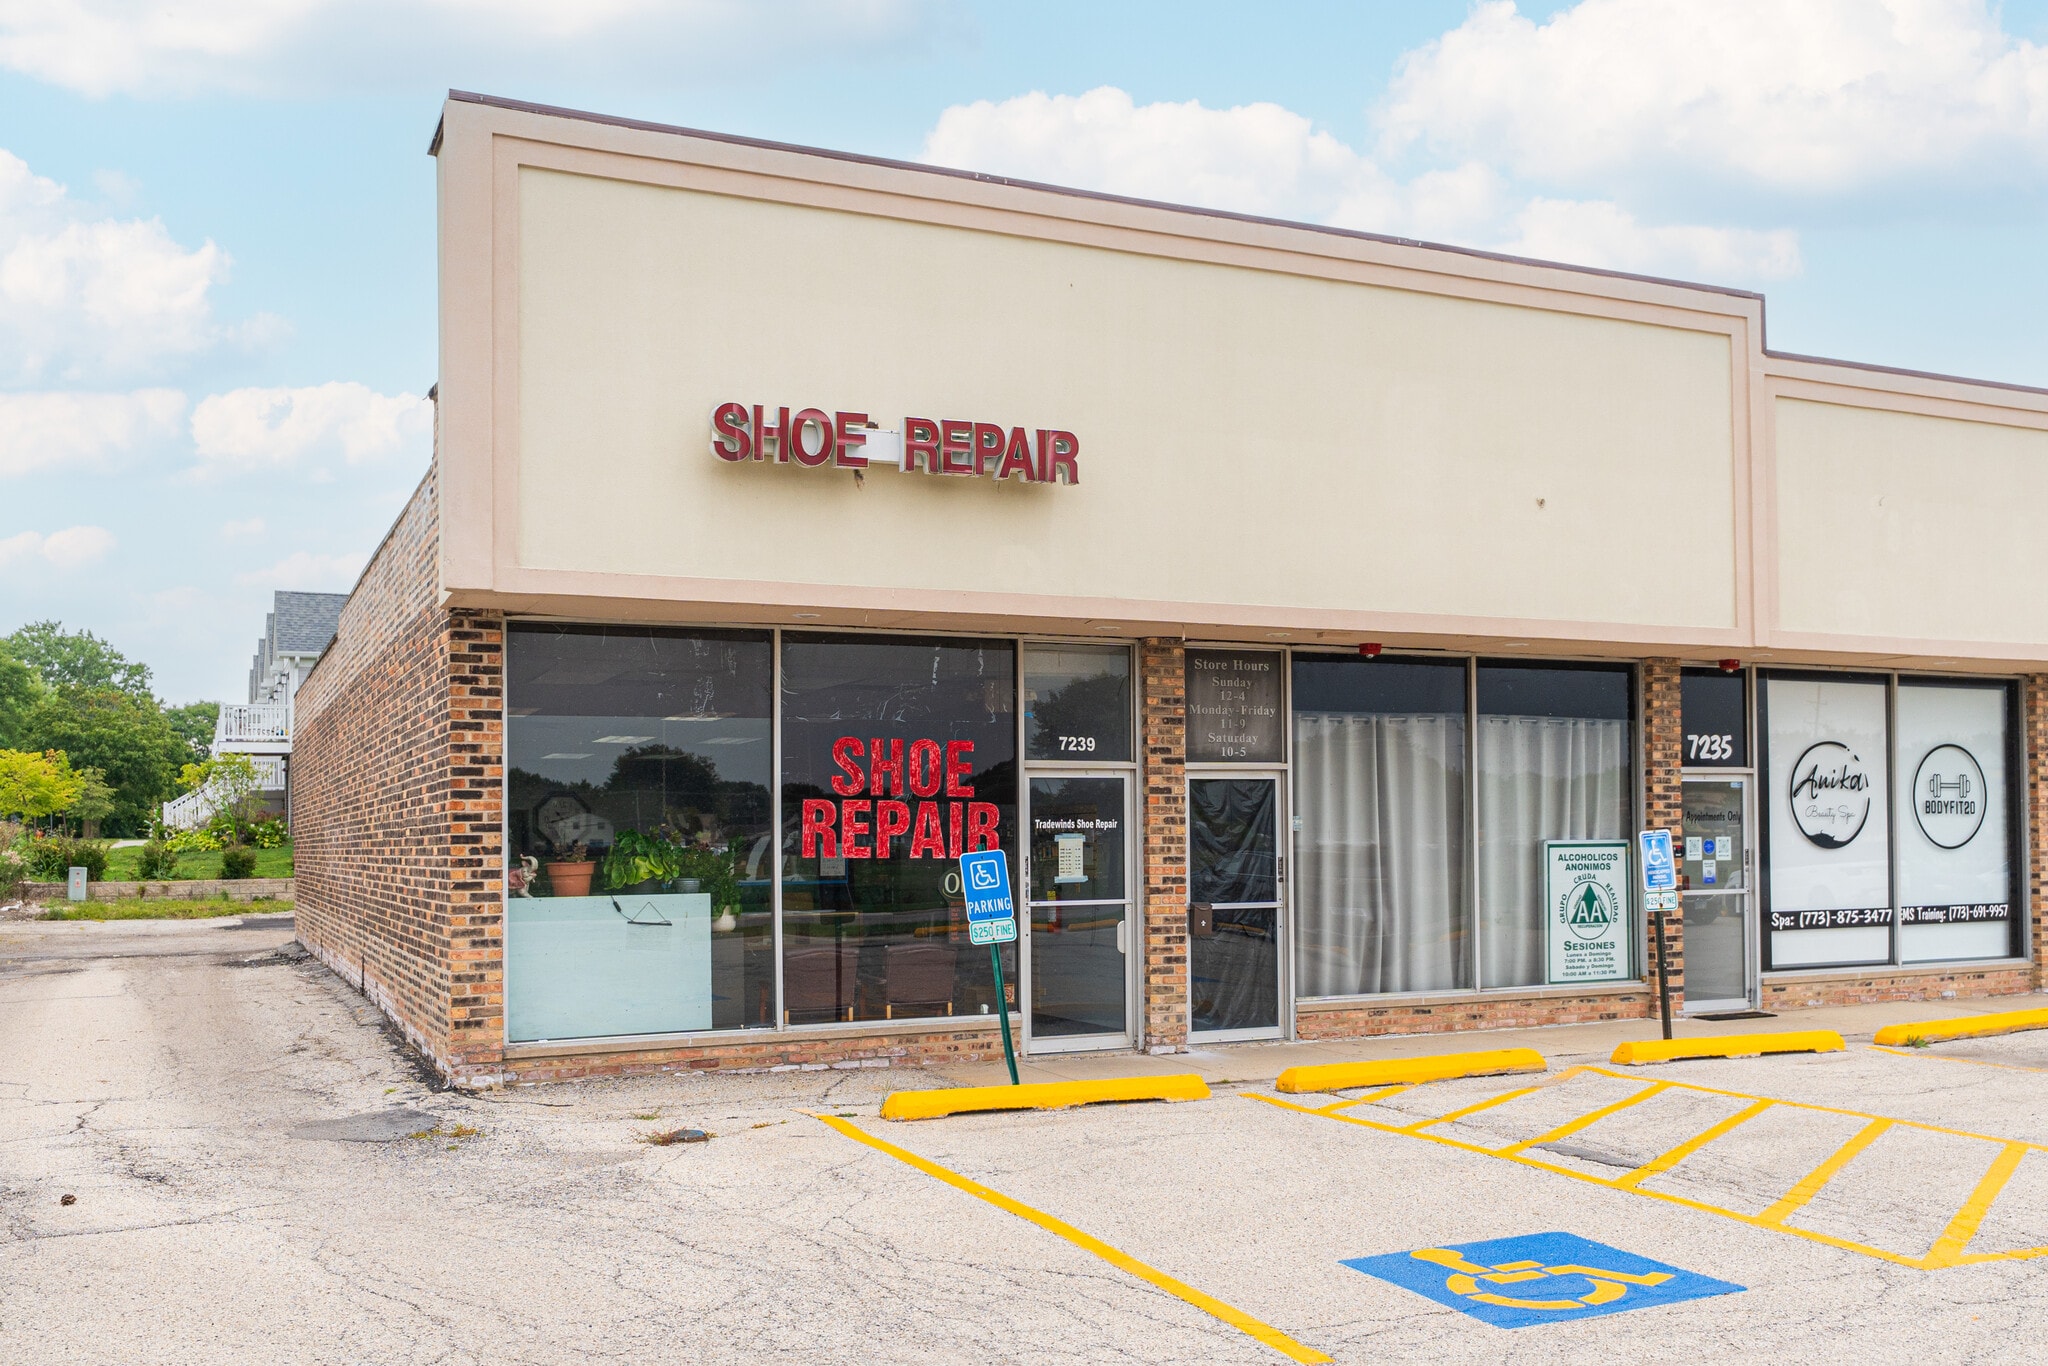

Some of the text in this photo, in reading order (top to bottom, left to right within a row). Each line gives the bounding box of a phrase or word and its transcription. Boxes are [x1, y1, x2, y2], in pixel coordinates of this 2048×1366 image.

[710, 402, 1080, 486] SHOE REPAIR
[1194, 659, 1270, 671] Store Hours
[1212, 677, 1252, 689] Sunday
[1220, 691, 1245, 701] 12-4
[1189, 704, 1276, 717] Monday-Friday
[1221, 719, 1246, 729] 11-9
[1058, 736, 1096, 752] 7239
[1208, 733, 1259, 745] Saturday
[1221, 747, 1247, 757] 10-5
[1687, 734, 1733, 760] 7235
[831, 736, 975, 798] SHOE
[1805, 804, 1836, 824] Beauty
[1838, 804, 1856, 824] Spa
[1925, 800, 1976, 815] BODYFIT20
[1685, 810, 1740, 824] Appointments Only
[801, 798, 1000, 859] REPAIR
[1035, 819, 1118, 830] Tradewinds Shoe Repair
[1558, 853, 1618, 861] ALCOHOLICOS
[1565, 862, 1611, 871] ANONIMOS
[1559, 893, 1567, 924] GRUPO
[1573, 873, 1597, 884] CRUDA
[1605, 882, 1619, 923] REALIDAD
[1646, 896, 1675, 905] $250 FINE
[968, 897, 1012, 915] PARKING
[1576, 900, 1603, 923] AA
[1771, 909, 1893, 930] Spa: (773)-875-3477
[1917, 907, 1947, 923] Training:
[1948, 904, 2009, 922] (773)-691-9957
[973, 926, 1013, 938] $250 FINE
